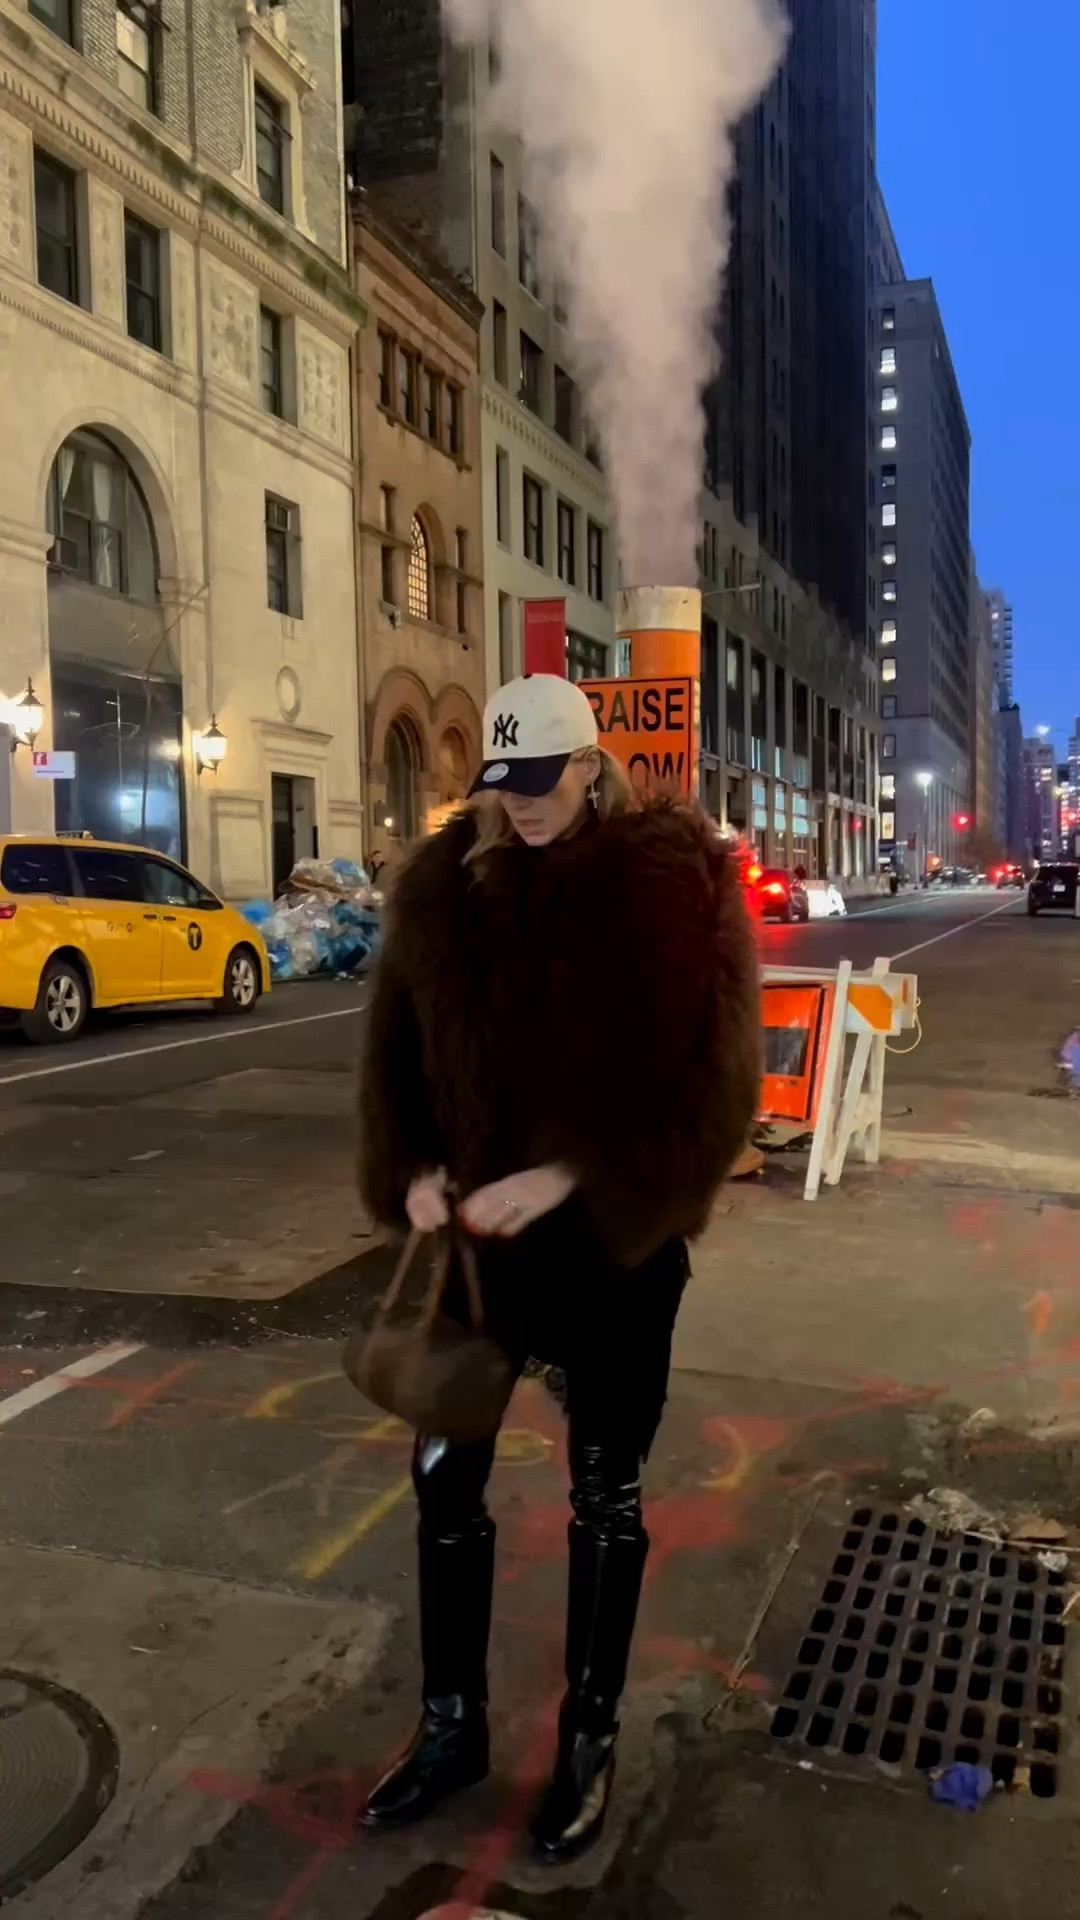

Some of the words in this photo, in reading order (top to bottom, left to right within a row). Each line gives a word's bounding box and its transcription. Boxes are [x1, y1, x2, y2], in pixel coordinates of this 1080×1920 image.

[585, 688, 684, 732] RAISE
[492, 712, 520, 748] NY
[628, 752, 684, 788] OW
